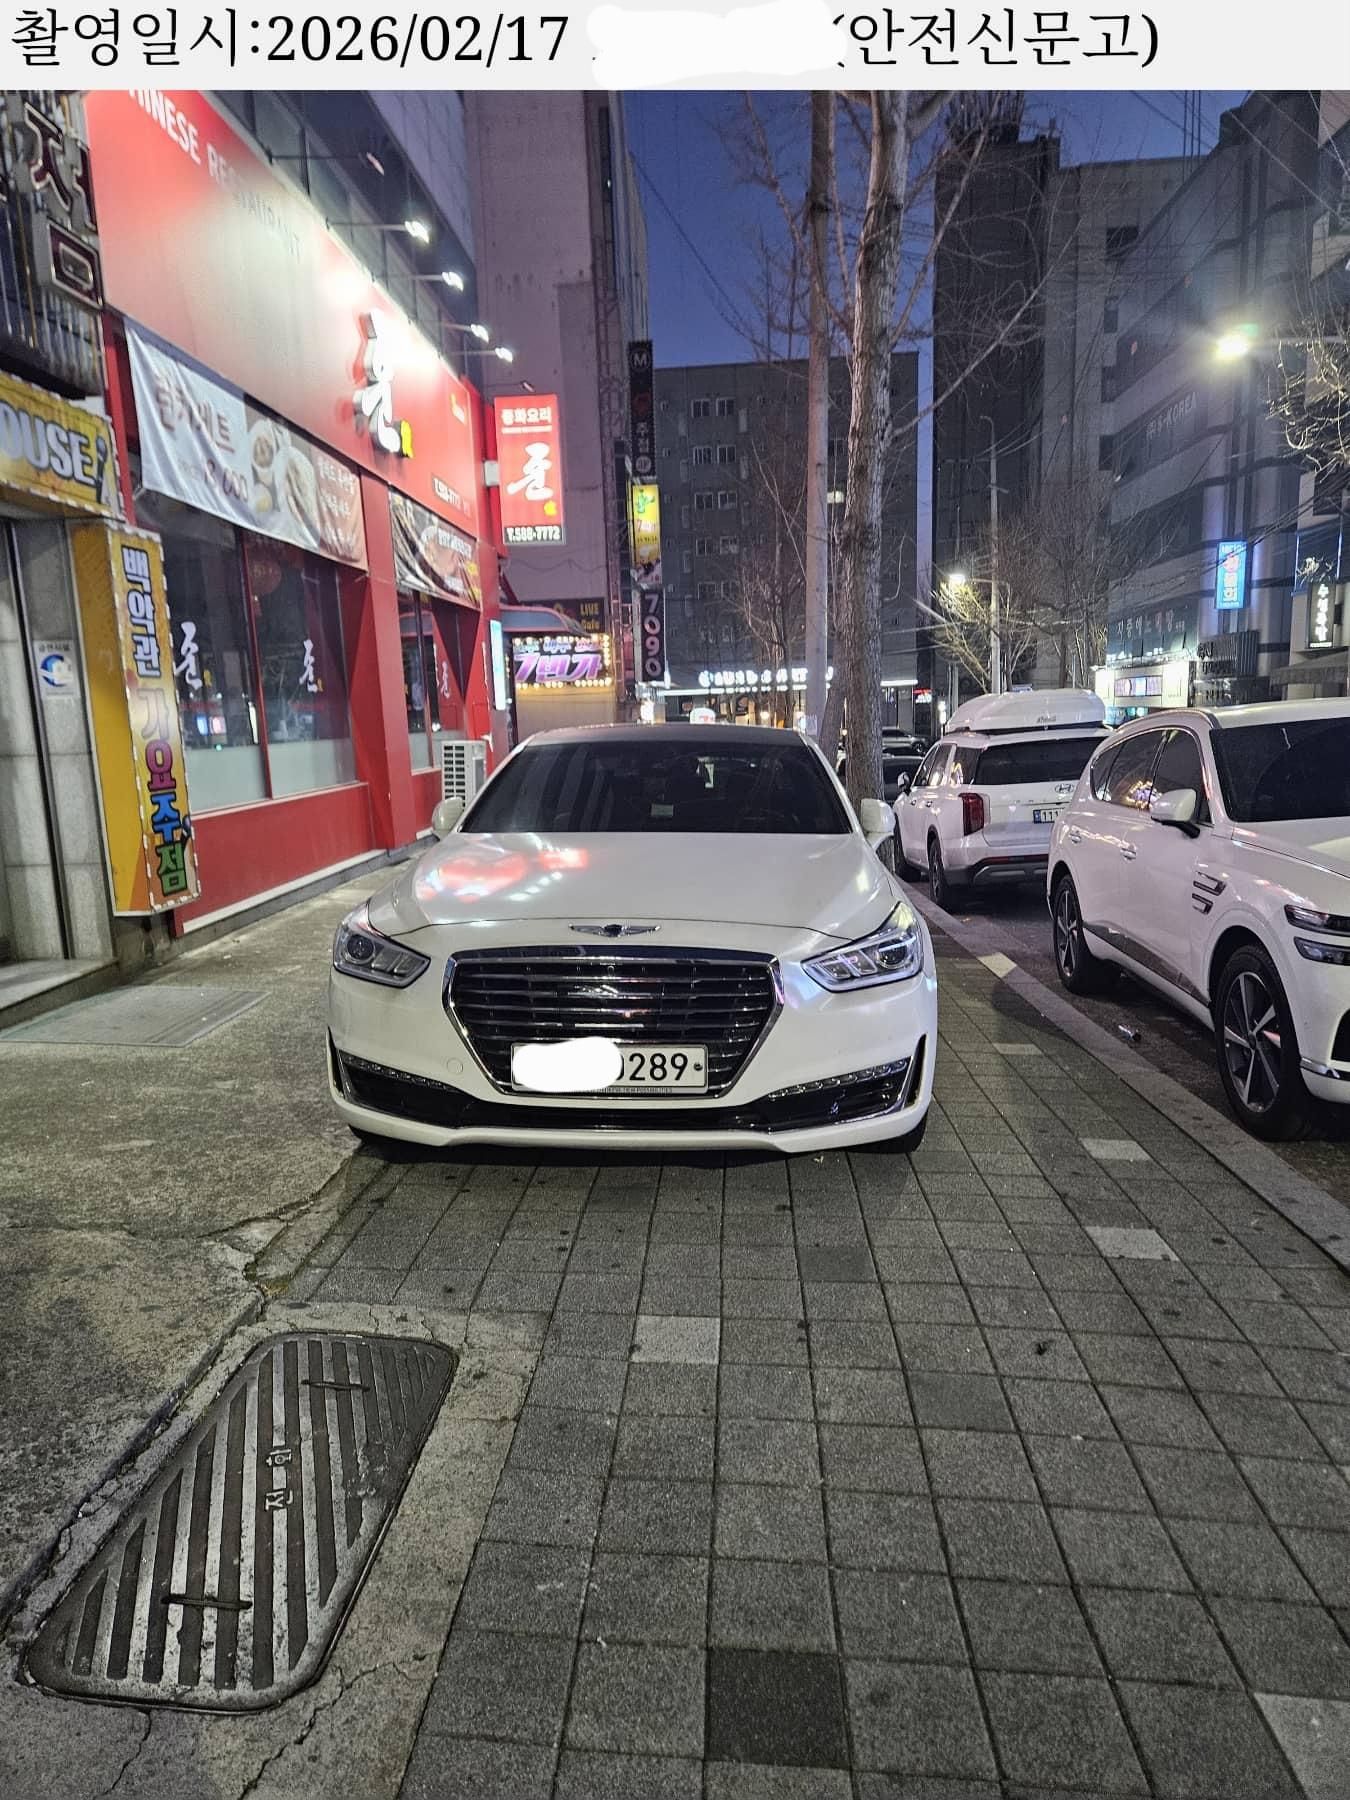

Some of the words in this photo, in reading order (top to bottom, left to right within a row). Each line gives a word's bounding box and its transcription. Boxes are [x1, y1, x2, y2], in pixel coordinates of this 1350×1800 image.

[502, 407, 552, 426] 중화요리
[122, 545, 162, 678] 백악관
[580, 603, 598, 616] LIVE
[643, 594, 661, 677] 7090
[514, 652, 603, 683] 7번가
[138, 686, 189, 898] 가요주점
[617, 1052, 689, 1081] 289
[265, 1448, 293, 1511] 전화
